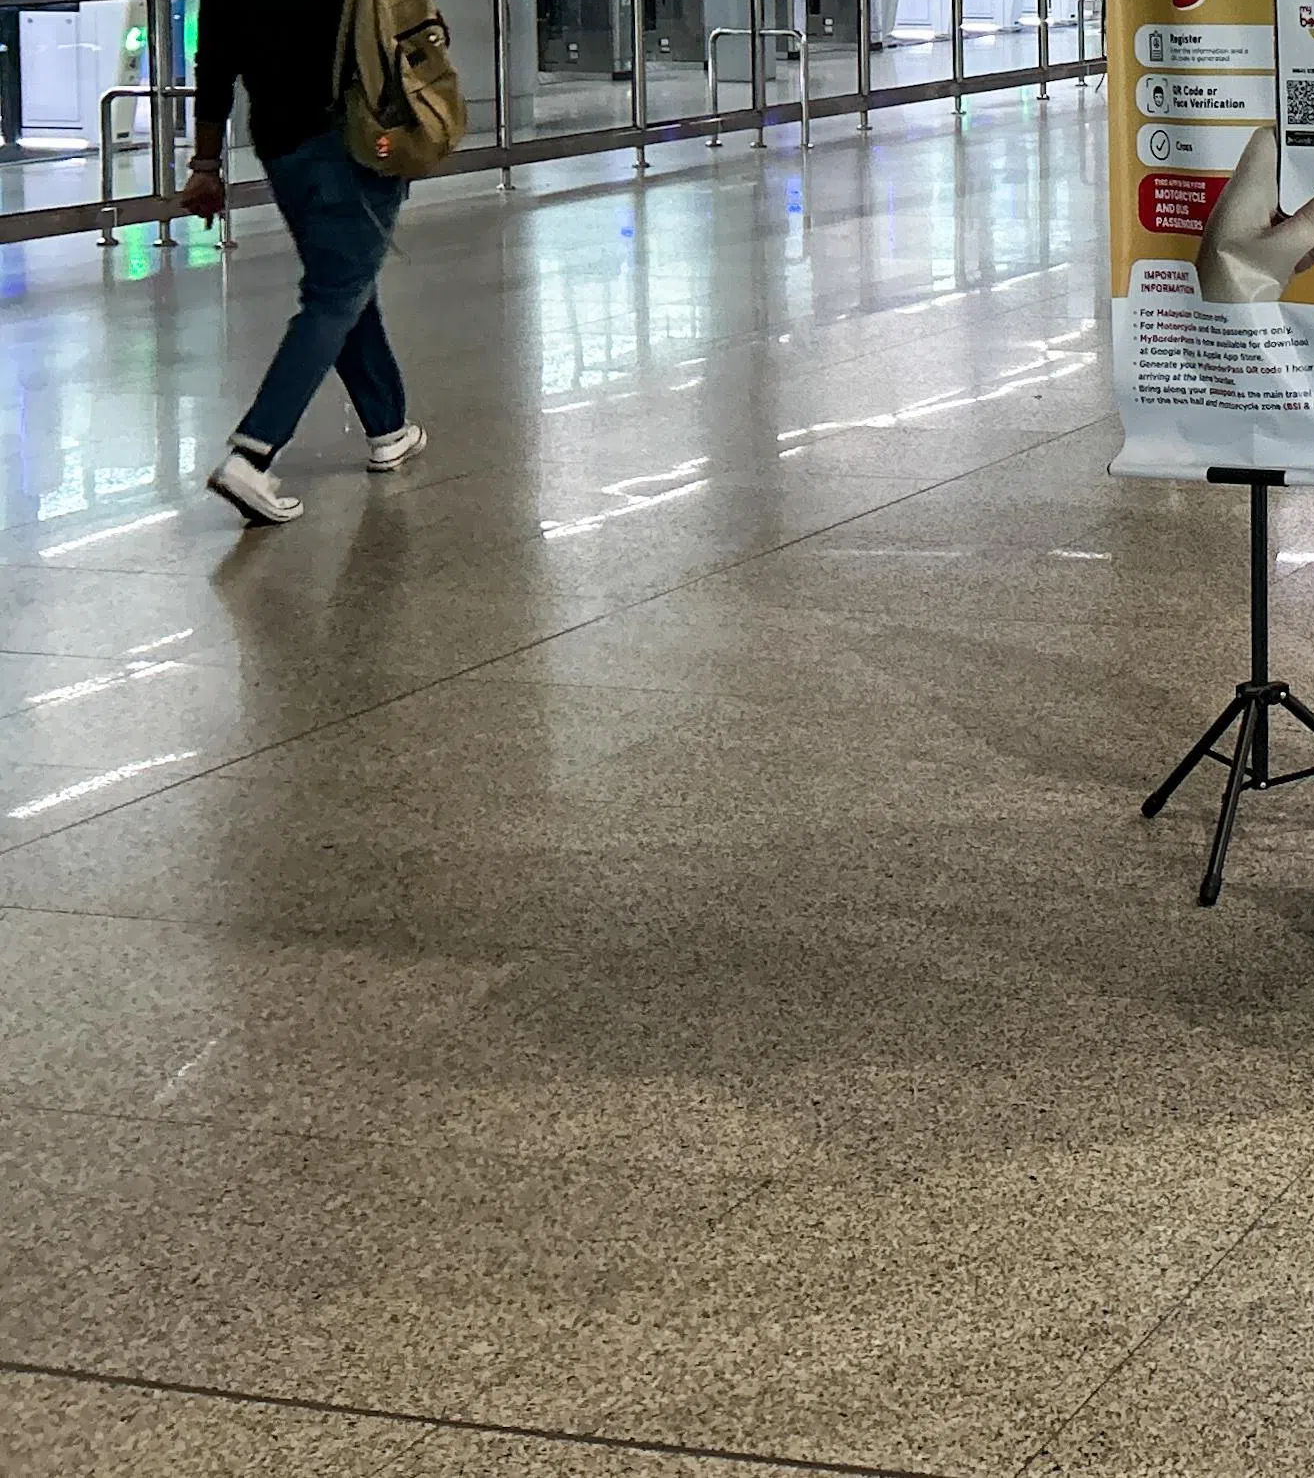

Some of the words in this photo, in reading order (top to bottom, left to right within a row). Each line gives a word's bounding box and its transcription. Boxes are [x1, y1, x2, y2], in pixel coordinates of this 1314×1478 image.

[1170, 34, 1202, 46] Register
[1183, 86, 1204, 96] Code
[1191, 98, 1245, 109] Verification
